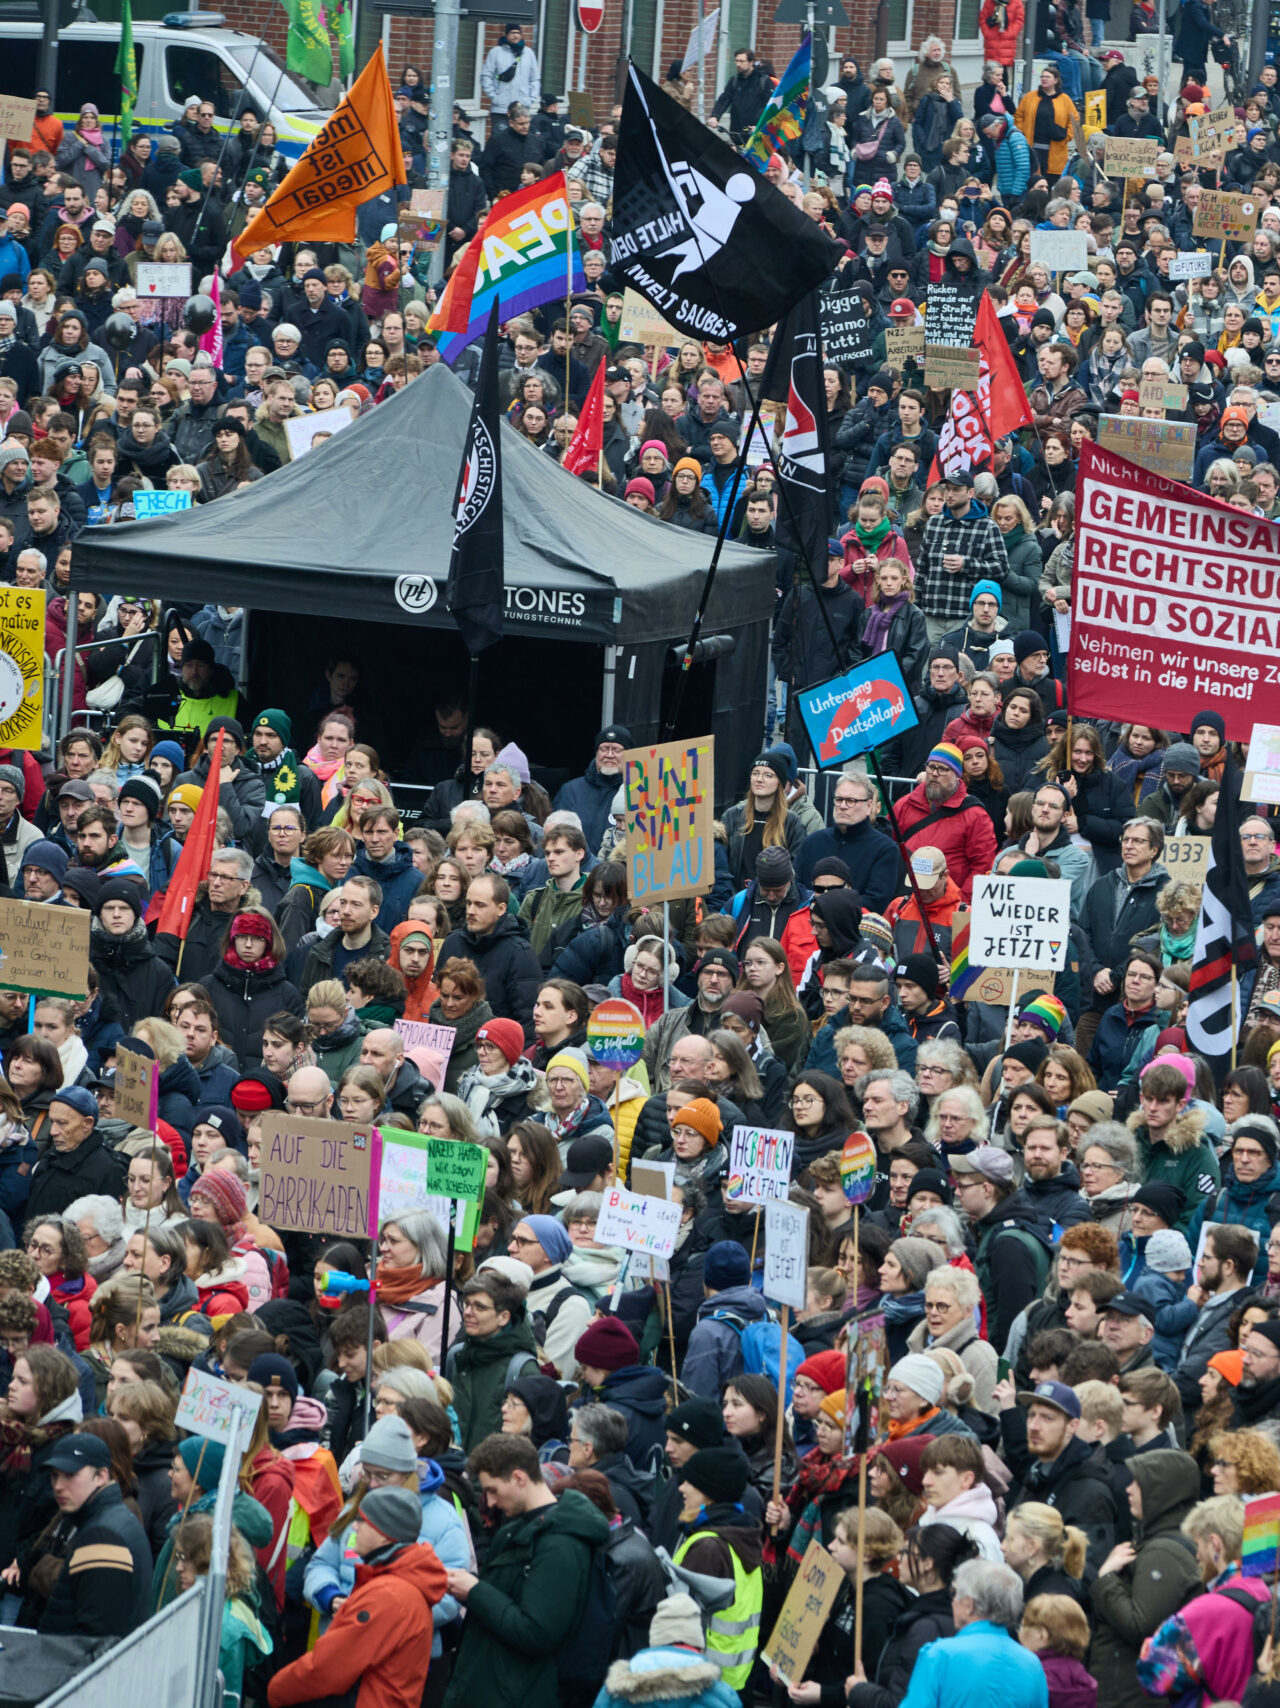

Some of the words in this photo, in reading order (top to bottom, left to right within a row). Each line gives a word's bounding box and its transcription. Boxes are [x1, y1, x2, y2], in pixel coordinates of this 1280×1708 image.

[1200, 192, 1217, 203] ICH
[1200, 203, 1230, 213] NAZIS
[1197, 221, 1221, 230] NICHT
[927, 282, 958, 294] Rücken
[926, 305, 940, 314] der
[927, 294, 957, 306] gerade
[957, 294, 975, 304] auf
[820, 317, 867, 338] Siamo
[940, 313, 963, 323] haben
[943, 322, 953, 331] ihr
[954, 322, 974, 333] nicht
[822, 333, 861, 351] Tutti
[887, 328, 905, 337] NZS
[925, 329, 942, 339] habt
[943, 330, 957, 339] und
[823, 349, 873, 365] ANTIFASCISTI
[1090, 453, 1140, 484] Nicht
[1146, 474, 1176, 494] nur
[133, 492, 188, 512] FRECH
[16, 595, 32, 610] es
[503, 585, 587, 616] TONES
[1081, 584, 1158, 627] UND
[503, 609, 584, 626] TUNGSTECHNIK
[1079, 633, 1154, 663] Nehmen
[1160, 651, 1190, 669] wir
[1193, 655, 1260, 681] unsere
[1073, 656, 1129, 680] selbst
[1134, 664, 1152, 684] in
[1158, 670, 1188, 689] die
[1193, 673, 1254, 700] Hand!
[809, 681, 873, 715] Untergang
[855, 694, 872, 714] für
[830, 697, 906, 745] Deutschland
[625, 745, 710, 812] BUNT
[635, 785, 708, 853] STATT
[1162, 842, 1204, 864] 1933
[633, 836, 704, 898] BLAU
[980, 882, 1015, 901] NIE
[989, 902, 1059, 924] WIEDER
[57, 916, 77, 937] der
[1010, 924, 1033, 937] IST
[984, 937, 1045, 961] JETZT
[1026, 970, 1055, 984] braun!
[395, 1020, 456, 1051] DEMOKRATIE
[603, 1033, 638, 1050] Vielfalt
[269, 1132, 305, 1167] AUF
[320, 1137, 348, 1171] DIE
[428, 1141, 454, 1158] NAZIS
[734, 1128, 794, 1171] HEBAMMEN
[426, 1179, 443, 1192] WAR
[261, 1172, 369, 1235] BARRIKADEN
[609, 1191, 648, 1216] Bunt
[656, 1209, 679, 1225] statt
[607, 1213, 633, 1226] braun
[601, 1226, 618, 1240] für
[626, 1228, 671, 1253] Vielfalt
